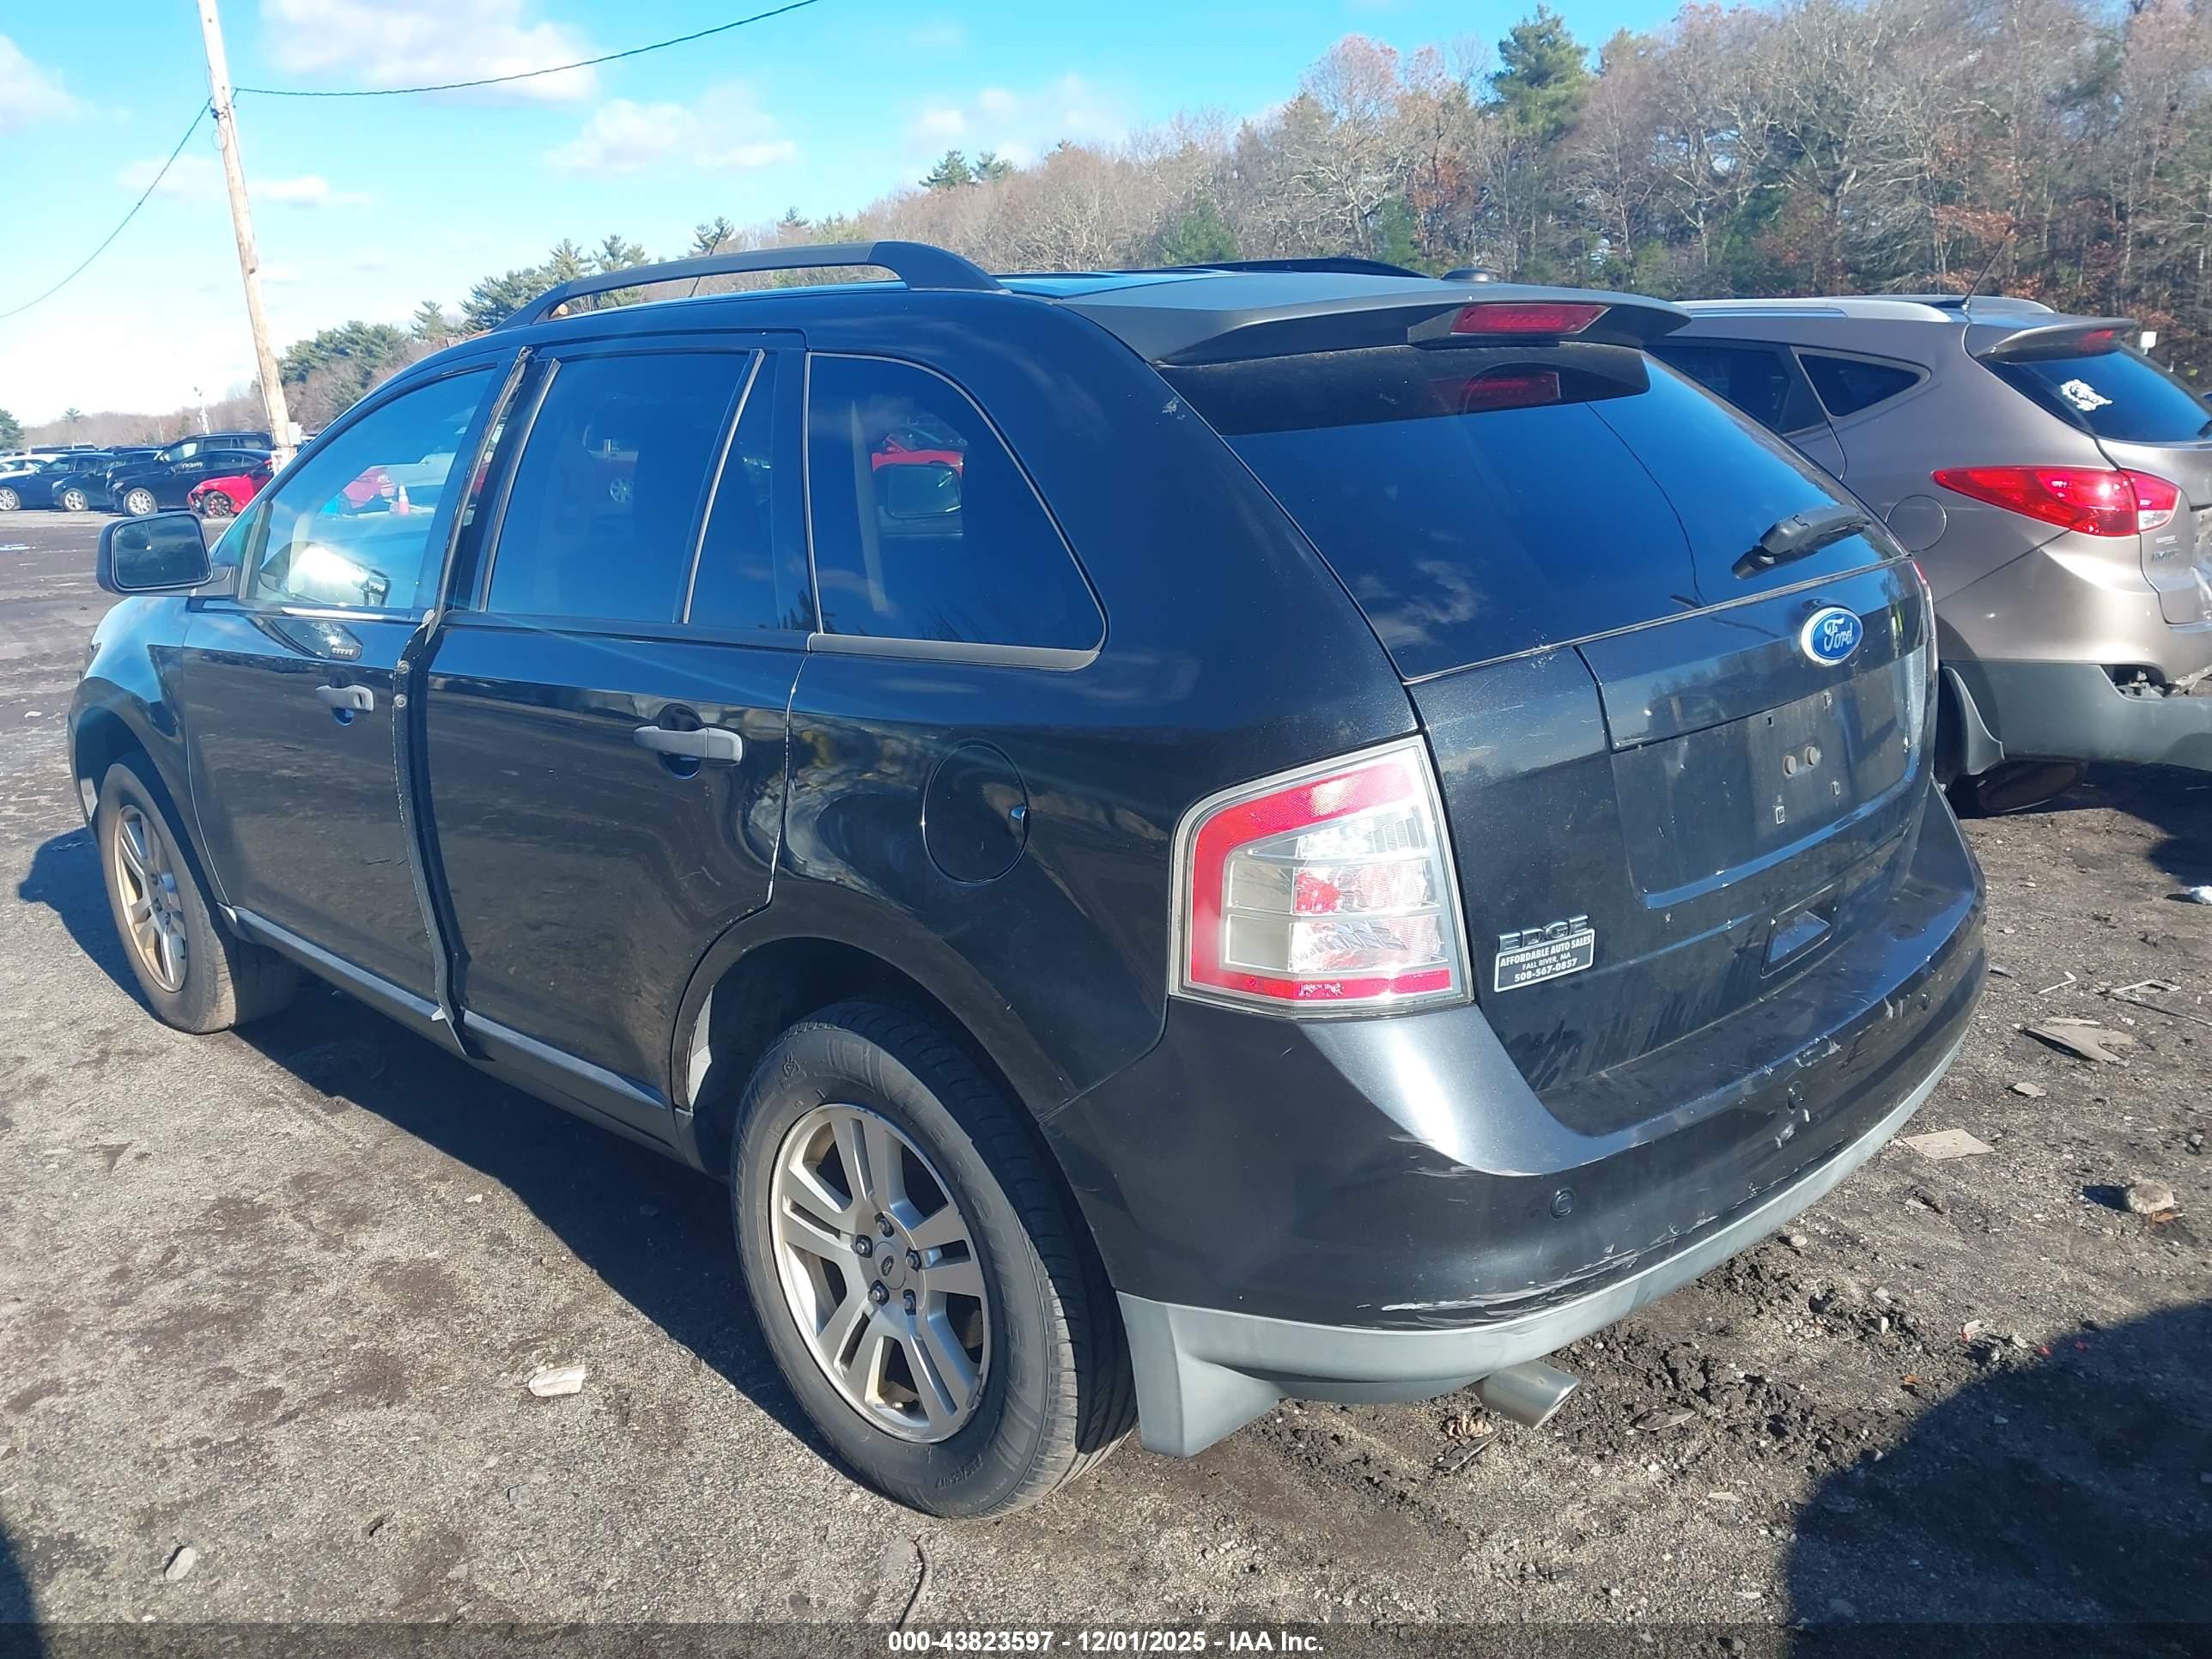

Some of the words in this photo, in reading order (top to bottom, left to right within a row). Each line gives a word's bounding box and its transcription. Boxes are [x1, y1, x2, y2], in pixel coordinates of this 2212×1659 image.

[1824, 617, 1855, 652] Ford
[1498, 915, 1589, 951] EDGE
[1500, 946, 1550, 967] AFFORDABLE
[1551, 941, 1571, 954] AUTO
[1571, 935, 1592, 949] SALES
[1522, 960, 1538, 970] FALL
[1538, 957, 1559, 966] RIVER,
[1559, 951, 1571, 960] MA
[1514, 957, 1578, 982] 508-567-0857
